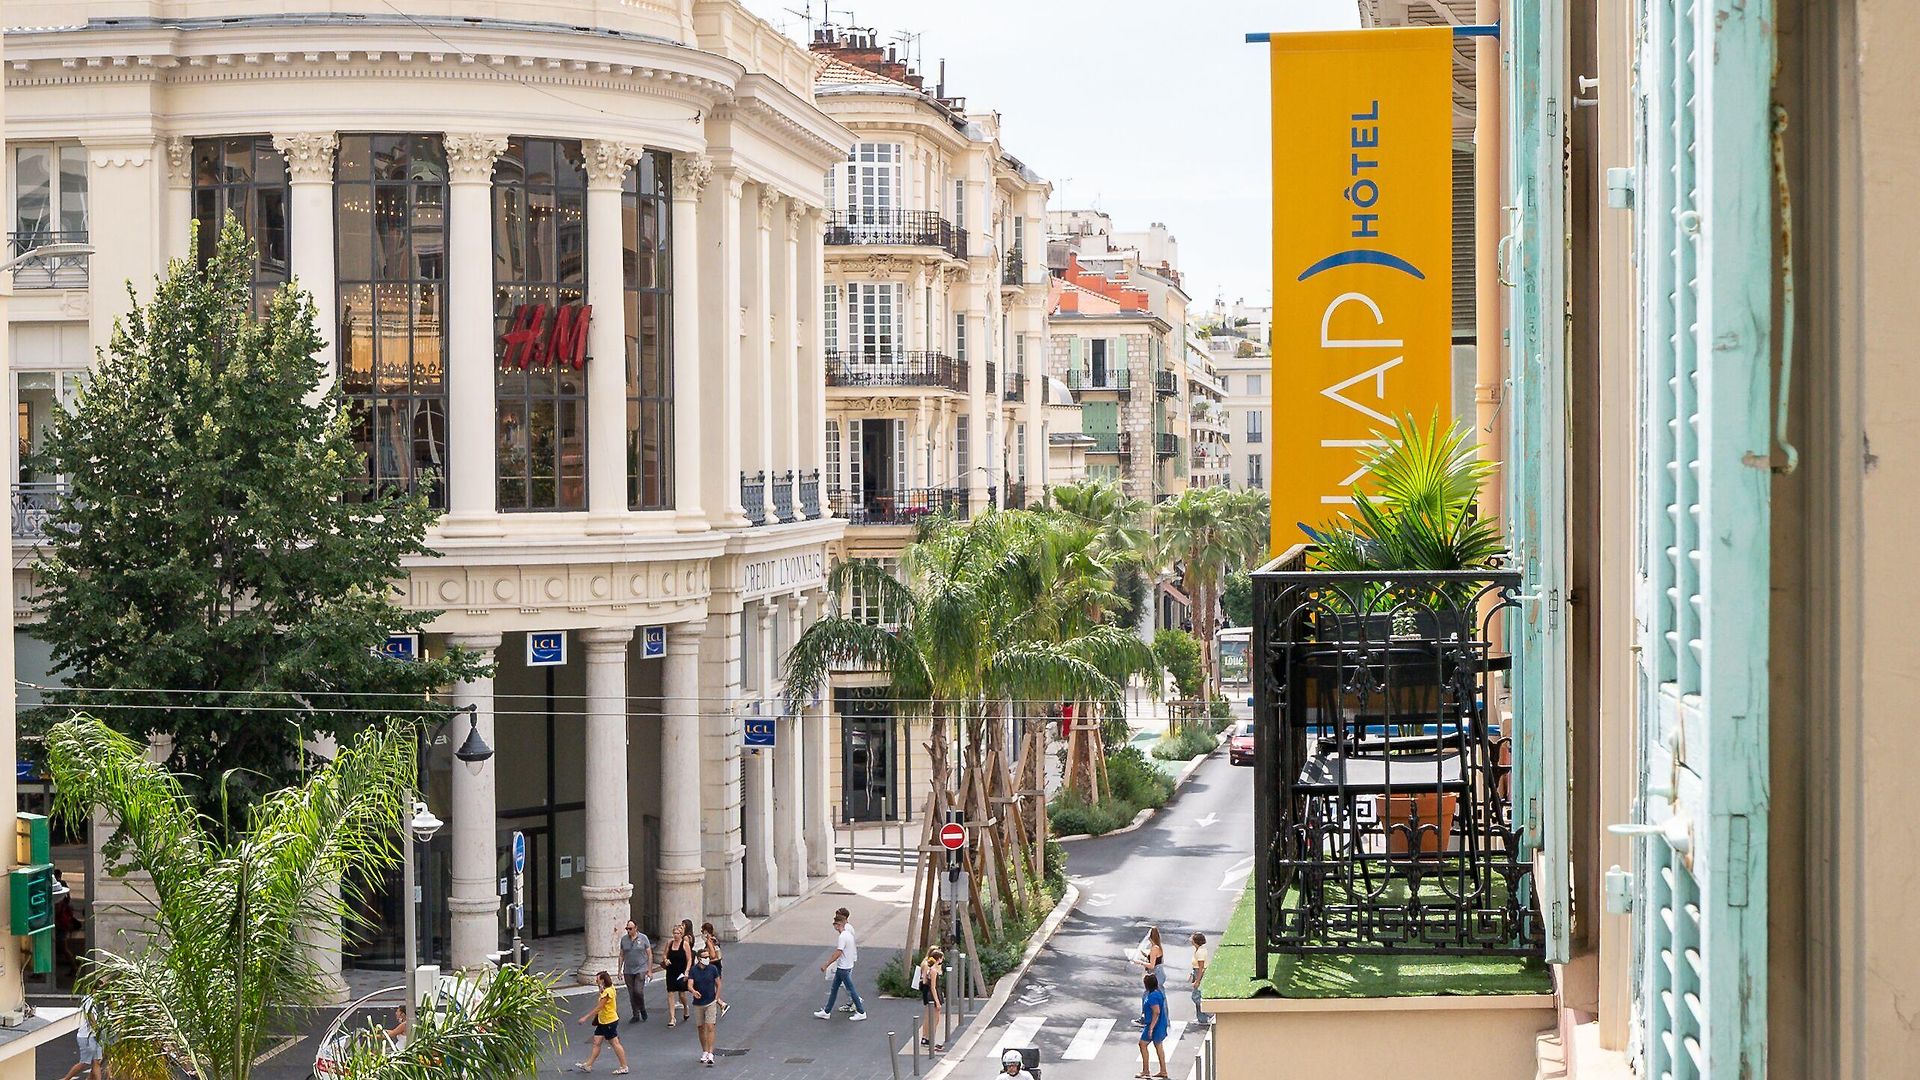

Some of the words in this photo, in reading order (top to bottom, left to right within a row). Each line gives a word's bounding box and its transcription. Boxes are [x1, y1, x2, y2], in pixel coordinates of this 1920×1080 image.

[1344, 100, 1379, 238] HÔTEL
[780, 553, 821, 585] LYONNAIS
[647, 632, 662, 642] LCL
[534, 639, 559, 649] LCL
[746, 724, 771, 734] LCL
